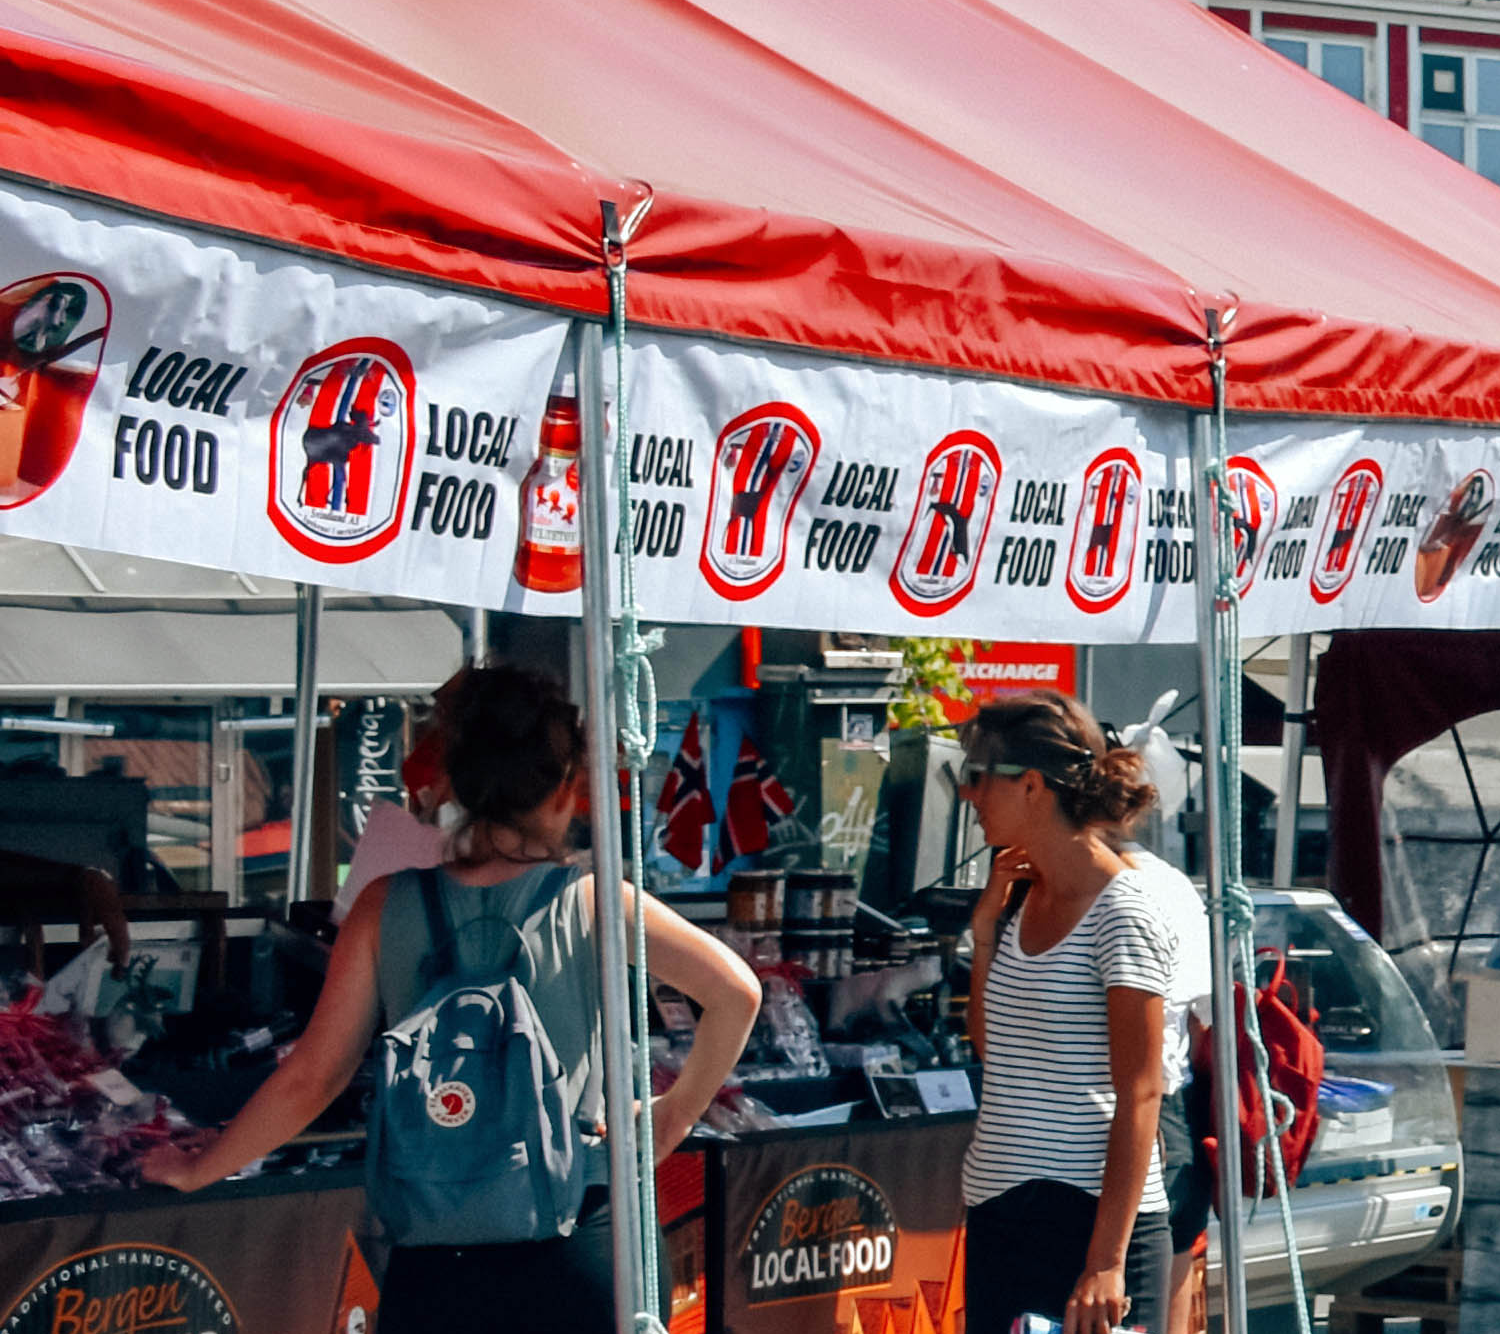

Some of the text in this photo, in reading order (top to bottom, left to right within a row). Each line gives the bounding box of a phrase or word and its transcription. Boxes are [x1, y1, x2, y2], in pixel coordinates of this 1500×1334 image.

[128, 347, 248, 416] LOCAL
[112, 416, 219, 495] FOOD
[425, 402, 518, 469] LOCAL
[630, 433, 694, 489] LOCAL
[411, 472, 499, 541] FOOD
[821, 460, 900, 513] LOCAL
[1010, 479, 1067, 527] LOCAL
[804, 518, 881, 573] FOOD
[995, 535, 1058, 587] FOOD
[1143, 539, 1196, 586] FOOD
[752, 1234, 892, 1289] LOCAL FOOD
[118, 1253, 232, 1326] HANDCRAFTED
